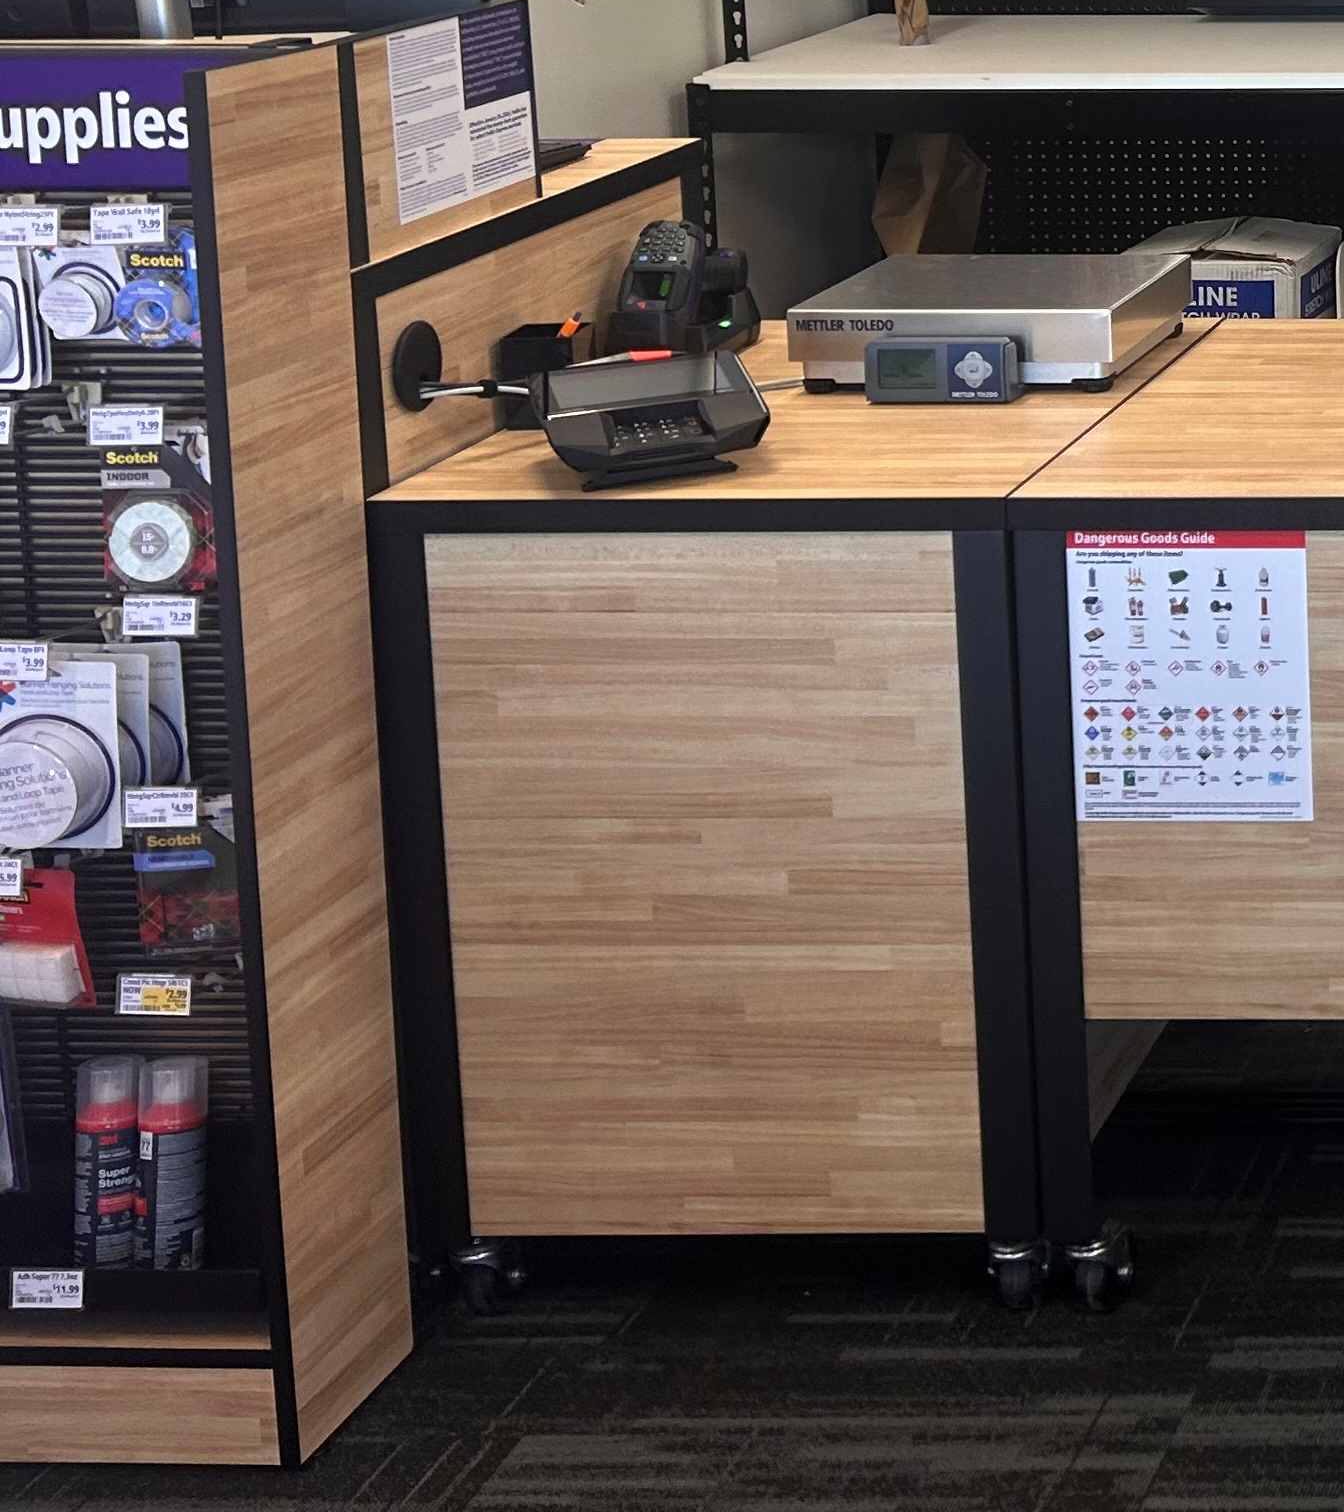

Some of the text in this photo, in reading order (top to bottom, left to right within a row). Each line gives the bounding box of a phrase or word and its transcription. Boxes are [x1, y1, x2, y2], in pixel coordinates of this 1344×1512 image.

[0, 90, 189, 164] upplies
[130, 254, 184, 268] Scotch
[796, 319, 894, 331] METTLER TOLEDO
[105, 451, 159, 464] Scotch
[106, 471, 150, 481] INDOOR
[1074, 531, 1216, 546] Dangerous Goods Guide
[147, 833, 202, 847] Scotch
[98, 1167, 131, 1179] Super
